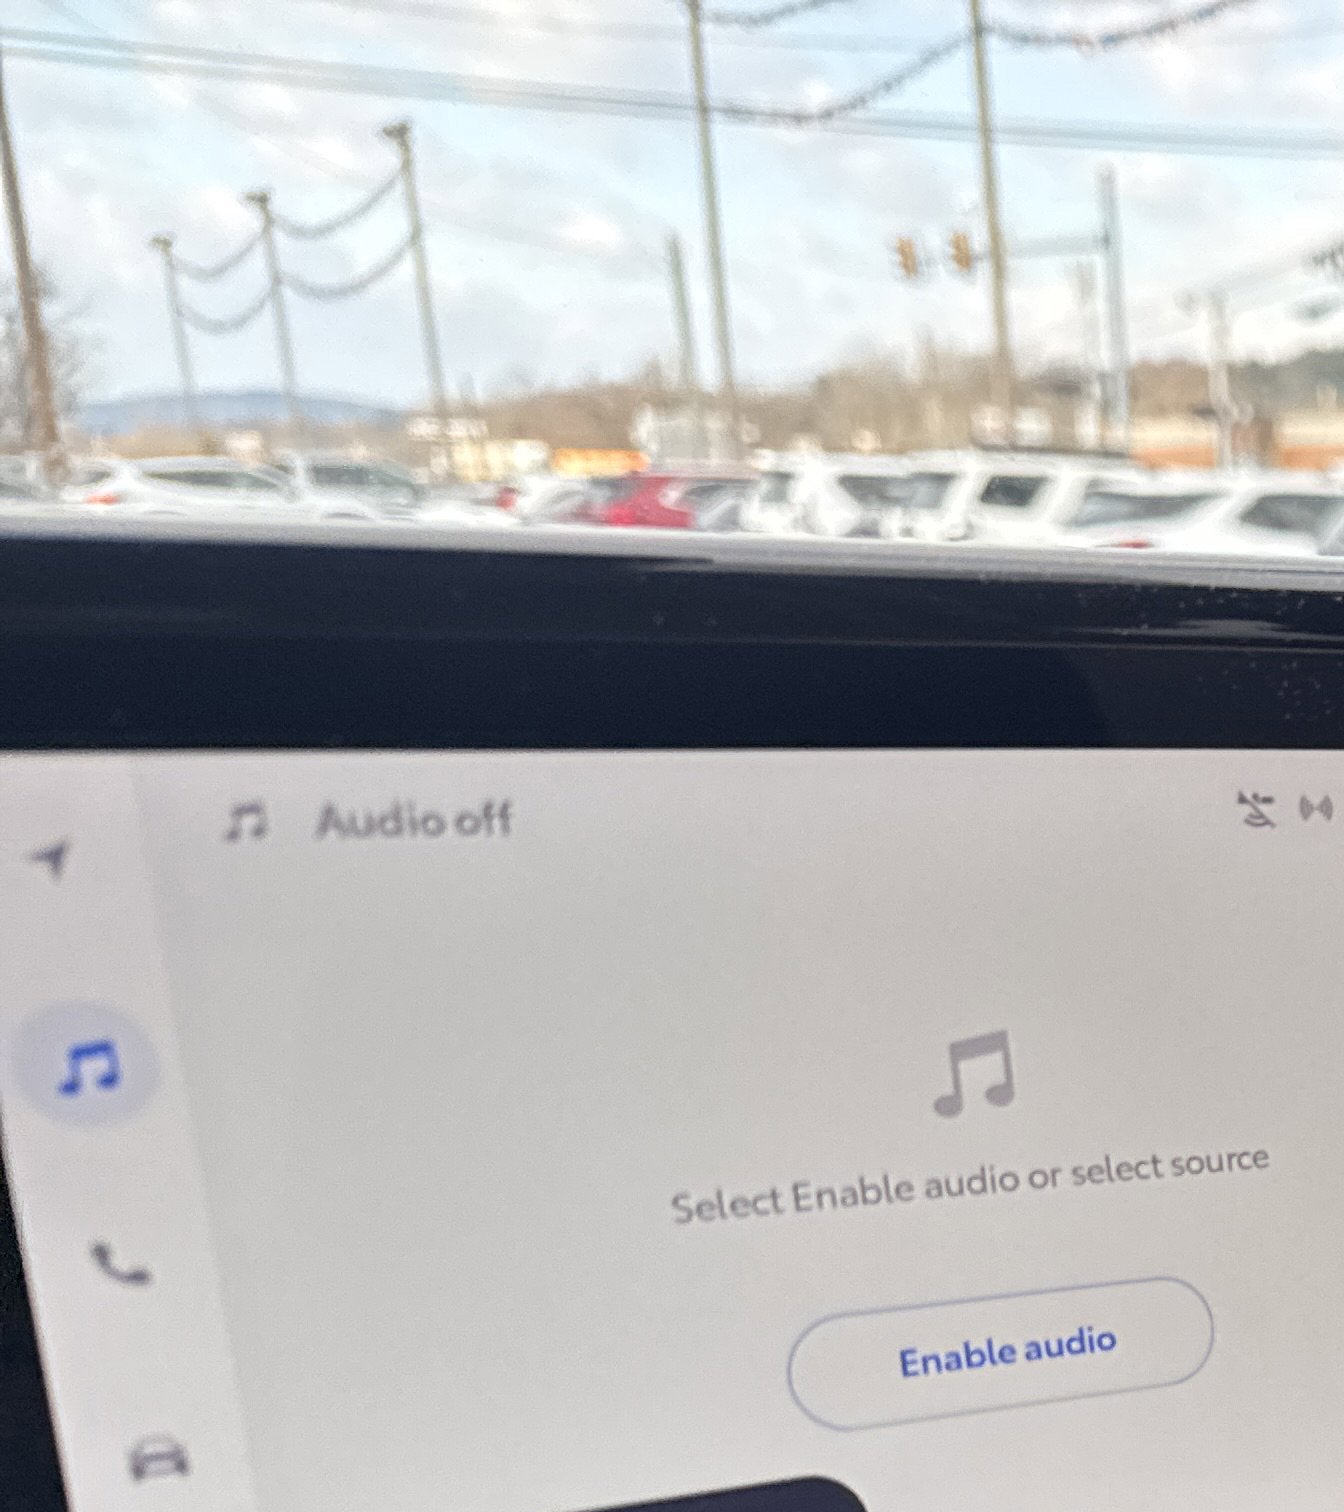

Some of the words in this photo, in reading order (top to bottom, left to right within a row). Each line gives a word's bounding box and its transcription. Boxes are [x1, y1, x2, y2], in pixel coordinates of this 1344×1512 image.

[313, 799, 446, 841] Audio
[454, 798, 511, 838] off
[671, 1187, 784, 1225] Select
[791, 1173, 915, 1213] Enable
[924, 1164, 1021, 1199] audio
[1028, 1166, 1063, 1190] or
[1071, 1154, 1166, 1187] select
[1170, 1148, 1271, 1178] source
[900, 1337, 1017, 1378] Enable
[1025, 1325, 1117, 1361] audio
